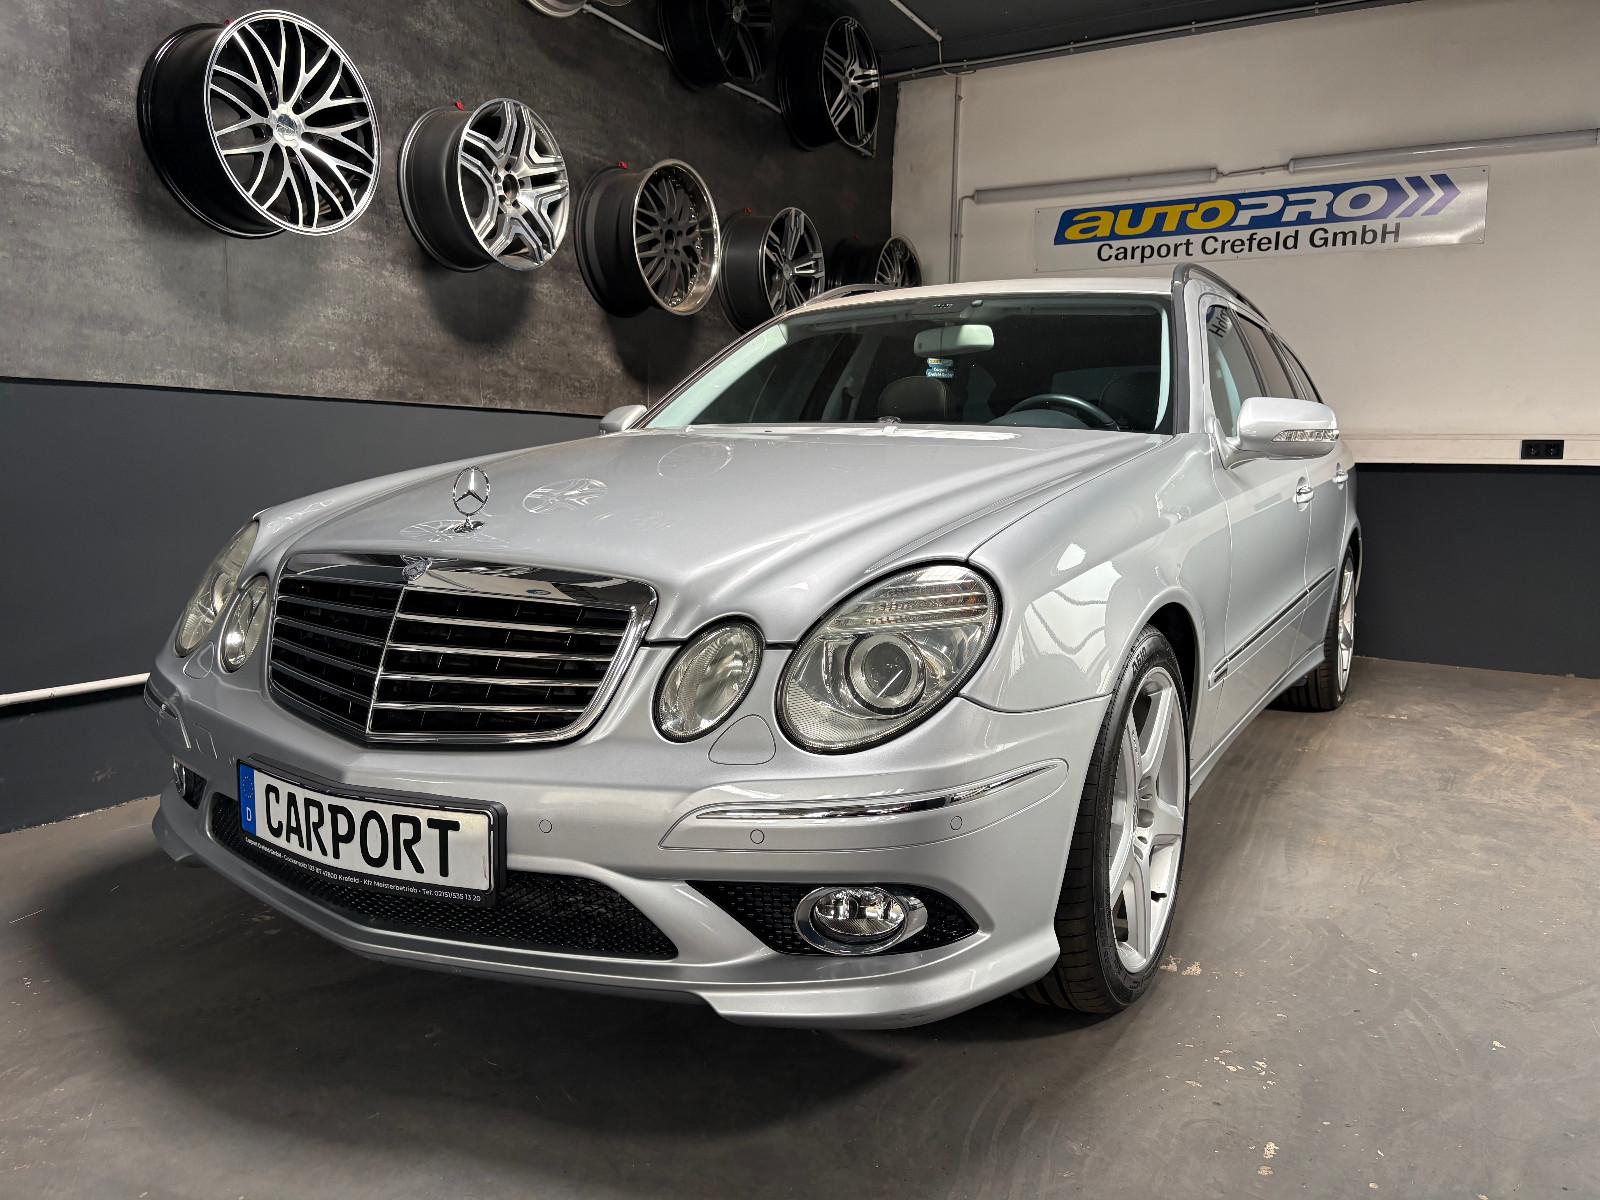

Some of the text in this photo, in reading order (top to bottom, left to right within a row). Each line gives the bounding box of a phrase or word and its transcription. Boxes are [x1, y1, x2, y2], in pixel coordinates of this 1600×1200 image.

[1097, 222, 1401, 264] Carport Crefeld GmbH
[246, 807, 252, 822] D
[265, 783, 461, 878] CARPORT
[338, 874, 359, 884] Krefeld
